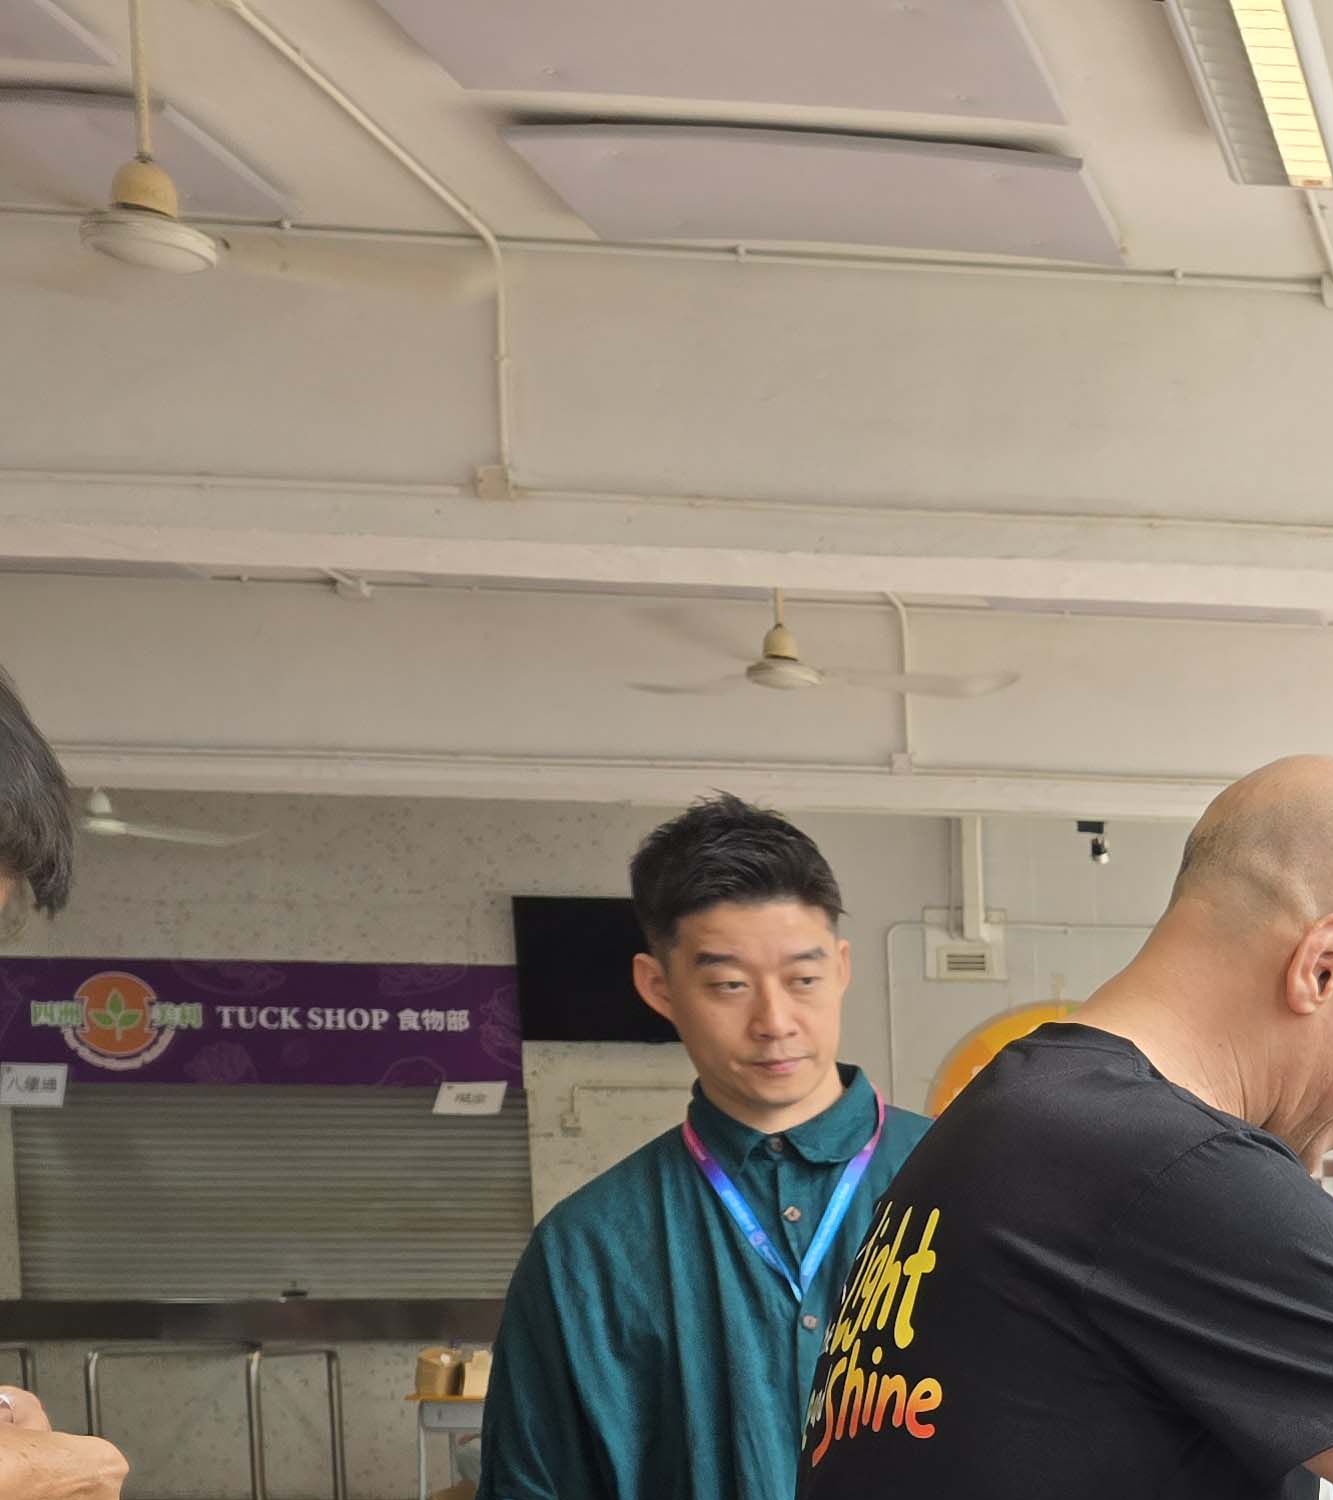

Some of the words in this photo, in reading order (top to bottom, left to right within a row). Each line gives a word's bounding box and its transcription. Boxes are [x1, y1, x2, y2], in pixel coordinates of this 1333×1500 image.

[216, 1005, 300, 1030] TUCK
[307, 1007, 389, 1031] SHOP
[398, 1009, 471, 1032] 食物部
